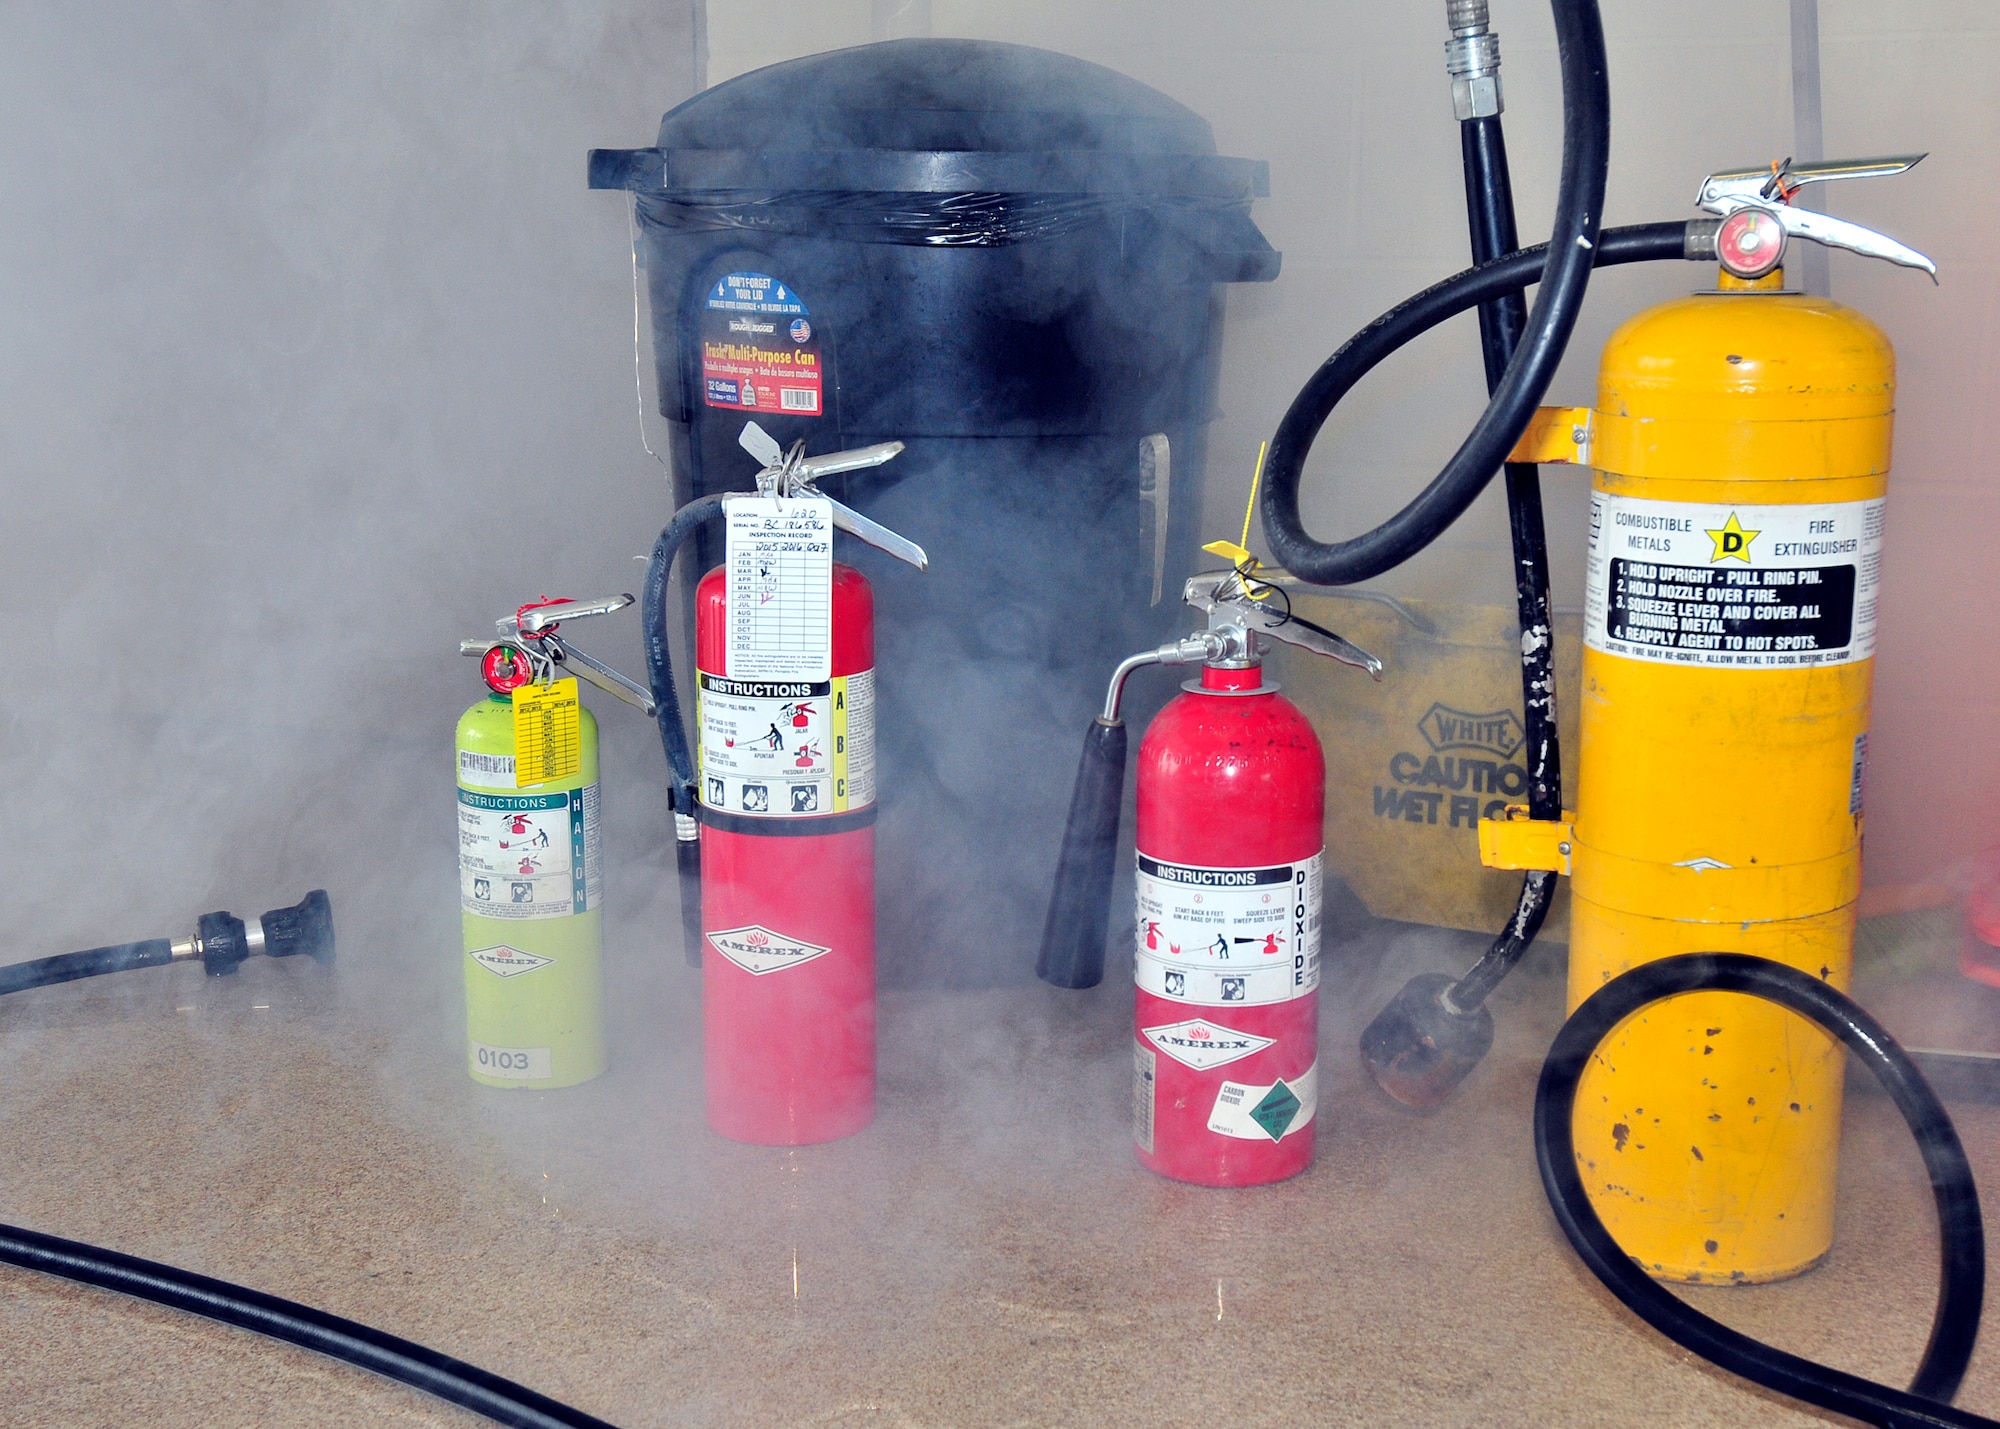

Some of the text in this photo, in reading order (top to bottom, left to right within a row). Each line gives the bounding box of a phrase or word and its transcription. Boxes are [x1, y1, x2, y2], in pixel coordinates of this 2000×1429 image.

[745, 278, 771, 289] FORGET
[735, 289, 764, 301] YOUR LID
[795, 349, 815, 365] Can
[708, 380, 737, 393] 32 Gallons
[1616, 512, 1835, 534] COMBUSTIBLE FIRE
[1628, 535, 1858, 556] METALS EXTINGUISHER
[1722, 532, 1743, 553] D
[1617, 562, 1627, 575] 1.
[1629, 563, 1657, 579] HOLD
[1659, 566, 1715, 585] UPRIGHT
[1727, 571, 1761, 585] PULL
[1763, 571, 1795, 585] RING
[1797, 570, 1823, 585] PIN.
[1616, 580, 1781, 603] 2. HOLD NOZZLE OVER FIRE.
[1615, 597, 1822, 620] 3. SQUEEZE LEVER AND COVER ALL
[1629, 612, 1727, 633] BURNING METAL
[1613, 625, 1819, 650] 4. REAPPLY AGENT TO HOT SPOTS.
[1632, 646, 1646, 656] FIRE
[1647, 648, 1662, 659] MAY
[1706, 654, 1733, 664] ALLOW
[1736, 655, 1762, 665] METAL
[1766, 656, 1776, 664] TO
[1778, 655, 1797, 664] COOL
[1800, 653, 1824, 664] BEFORE
[708, 678, 812, 697] INSTRUCTIONS
[836, 691, 844, 710] A
[1434, 712, 1511, 750] WHITE
[836, 736, 844, 753] B
[1390, 751, 1529, 797] CAUTIO
[836, 779, 844, 797] C
[1373, 785, 1443, 825] WET
[1157, 865, 1257, 885] INSTRUCTIONS
[1175, 906, 1190, 914] START
[1246, 907, 1285, 917] SQUEEZE LEVER
[1295, 870, 1305, 986] DIOXIDE
[720, 939, 805, 956] AMEREX
[478, 954, 538, 965] AMEREX
[1157, 1034, 1250, 1049] AMEREX
[478, 1047, 529, 1070] 0103
[1223, 1085, 1245, 1097] CARBON
